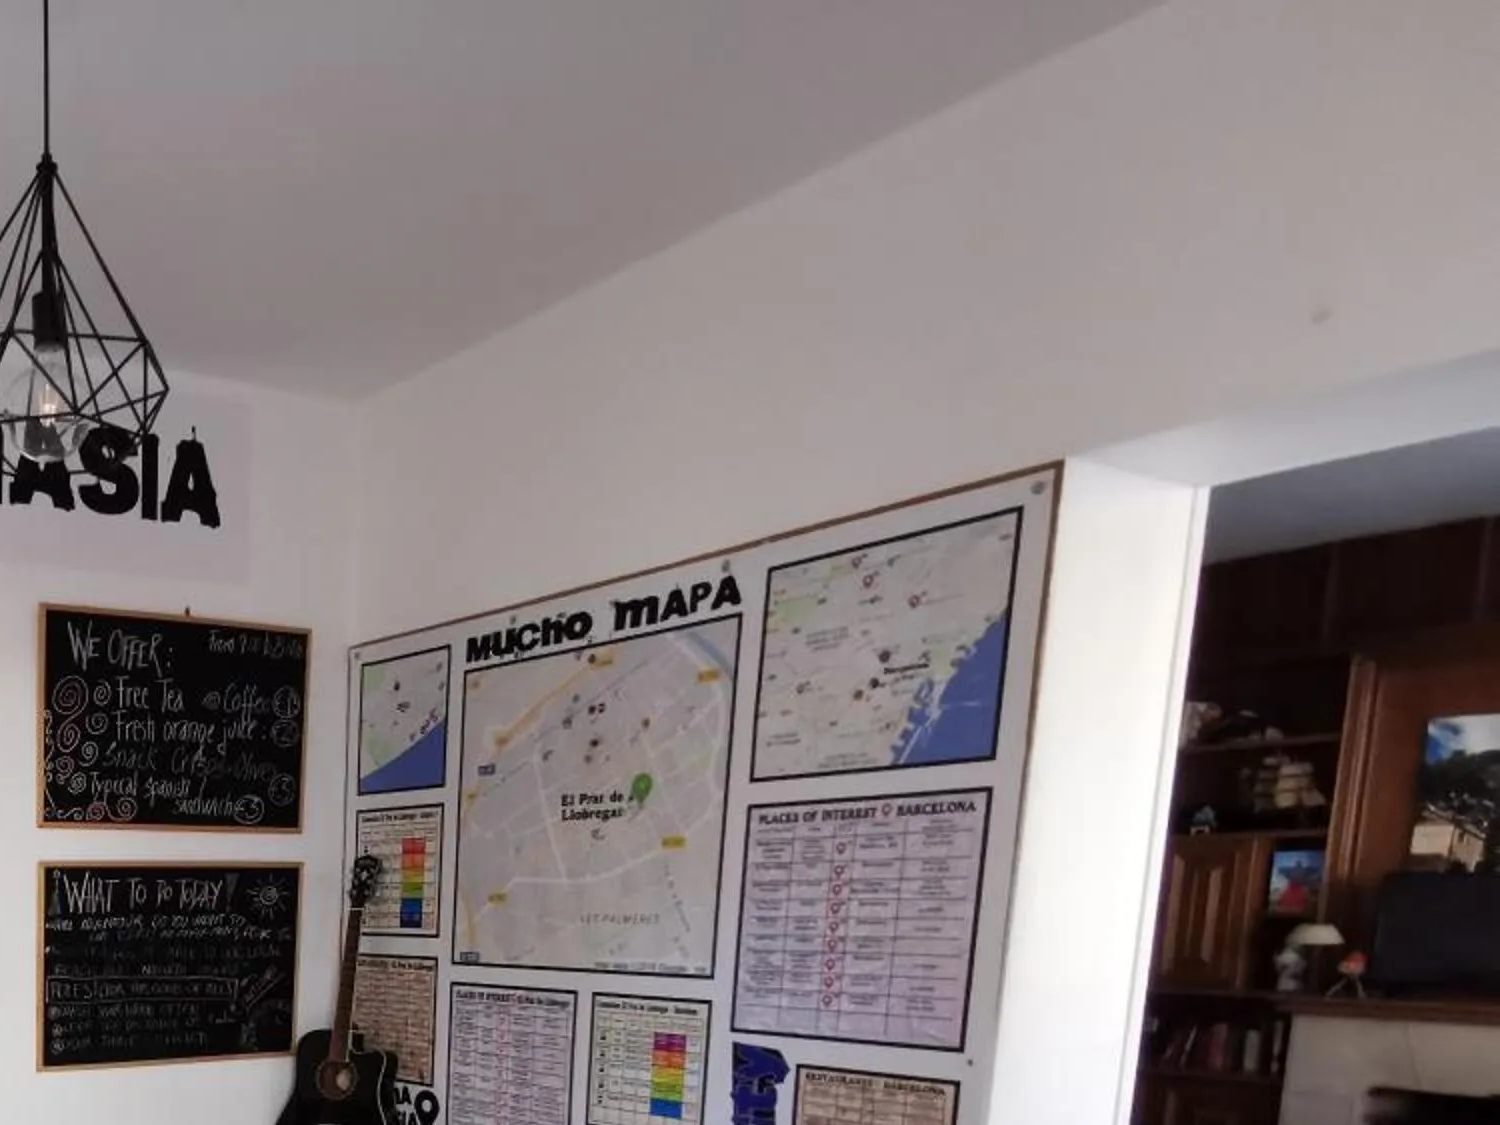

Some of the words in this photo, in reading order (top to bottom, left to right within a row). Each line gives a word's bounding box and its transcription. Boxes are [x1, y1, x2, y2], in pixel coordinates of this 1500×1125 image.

[116, 675, 150, 709] Free
[155, 677, 185, 713] Tea
[112, 709, 156, 743] Fresh
[162, 718, 216, 756] orange
[821, 807, 878, 821] INTEREST
